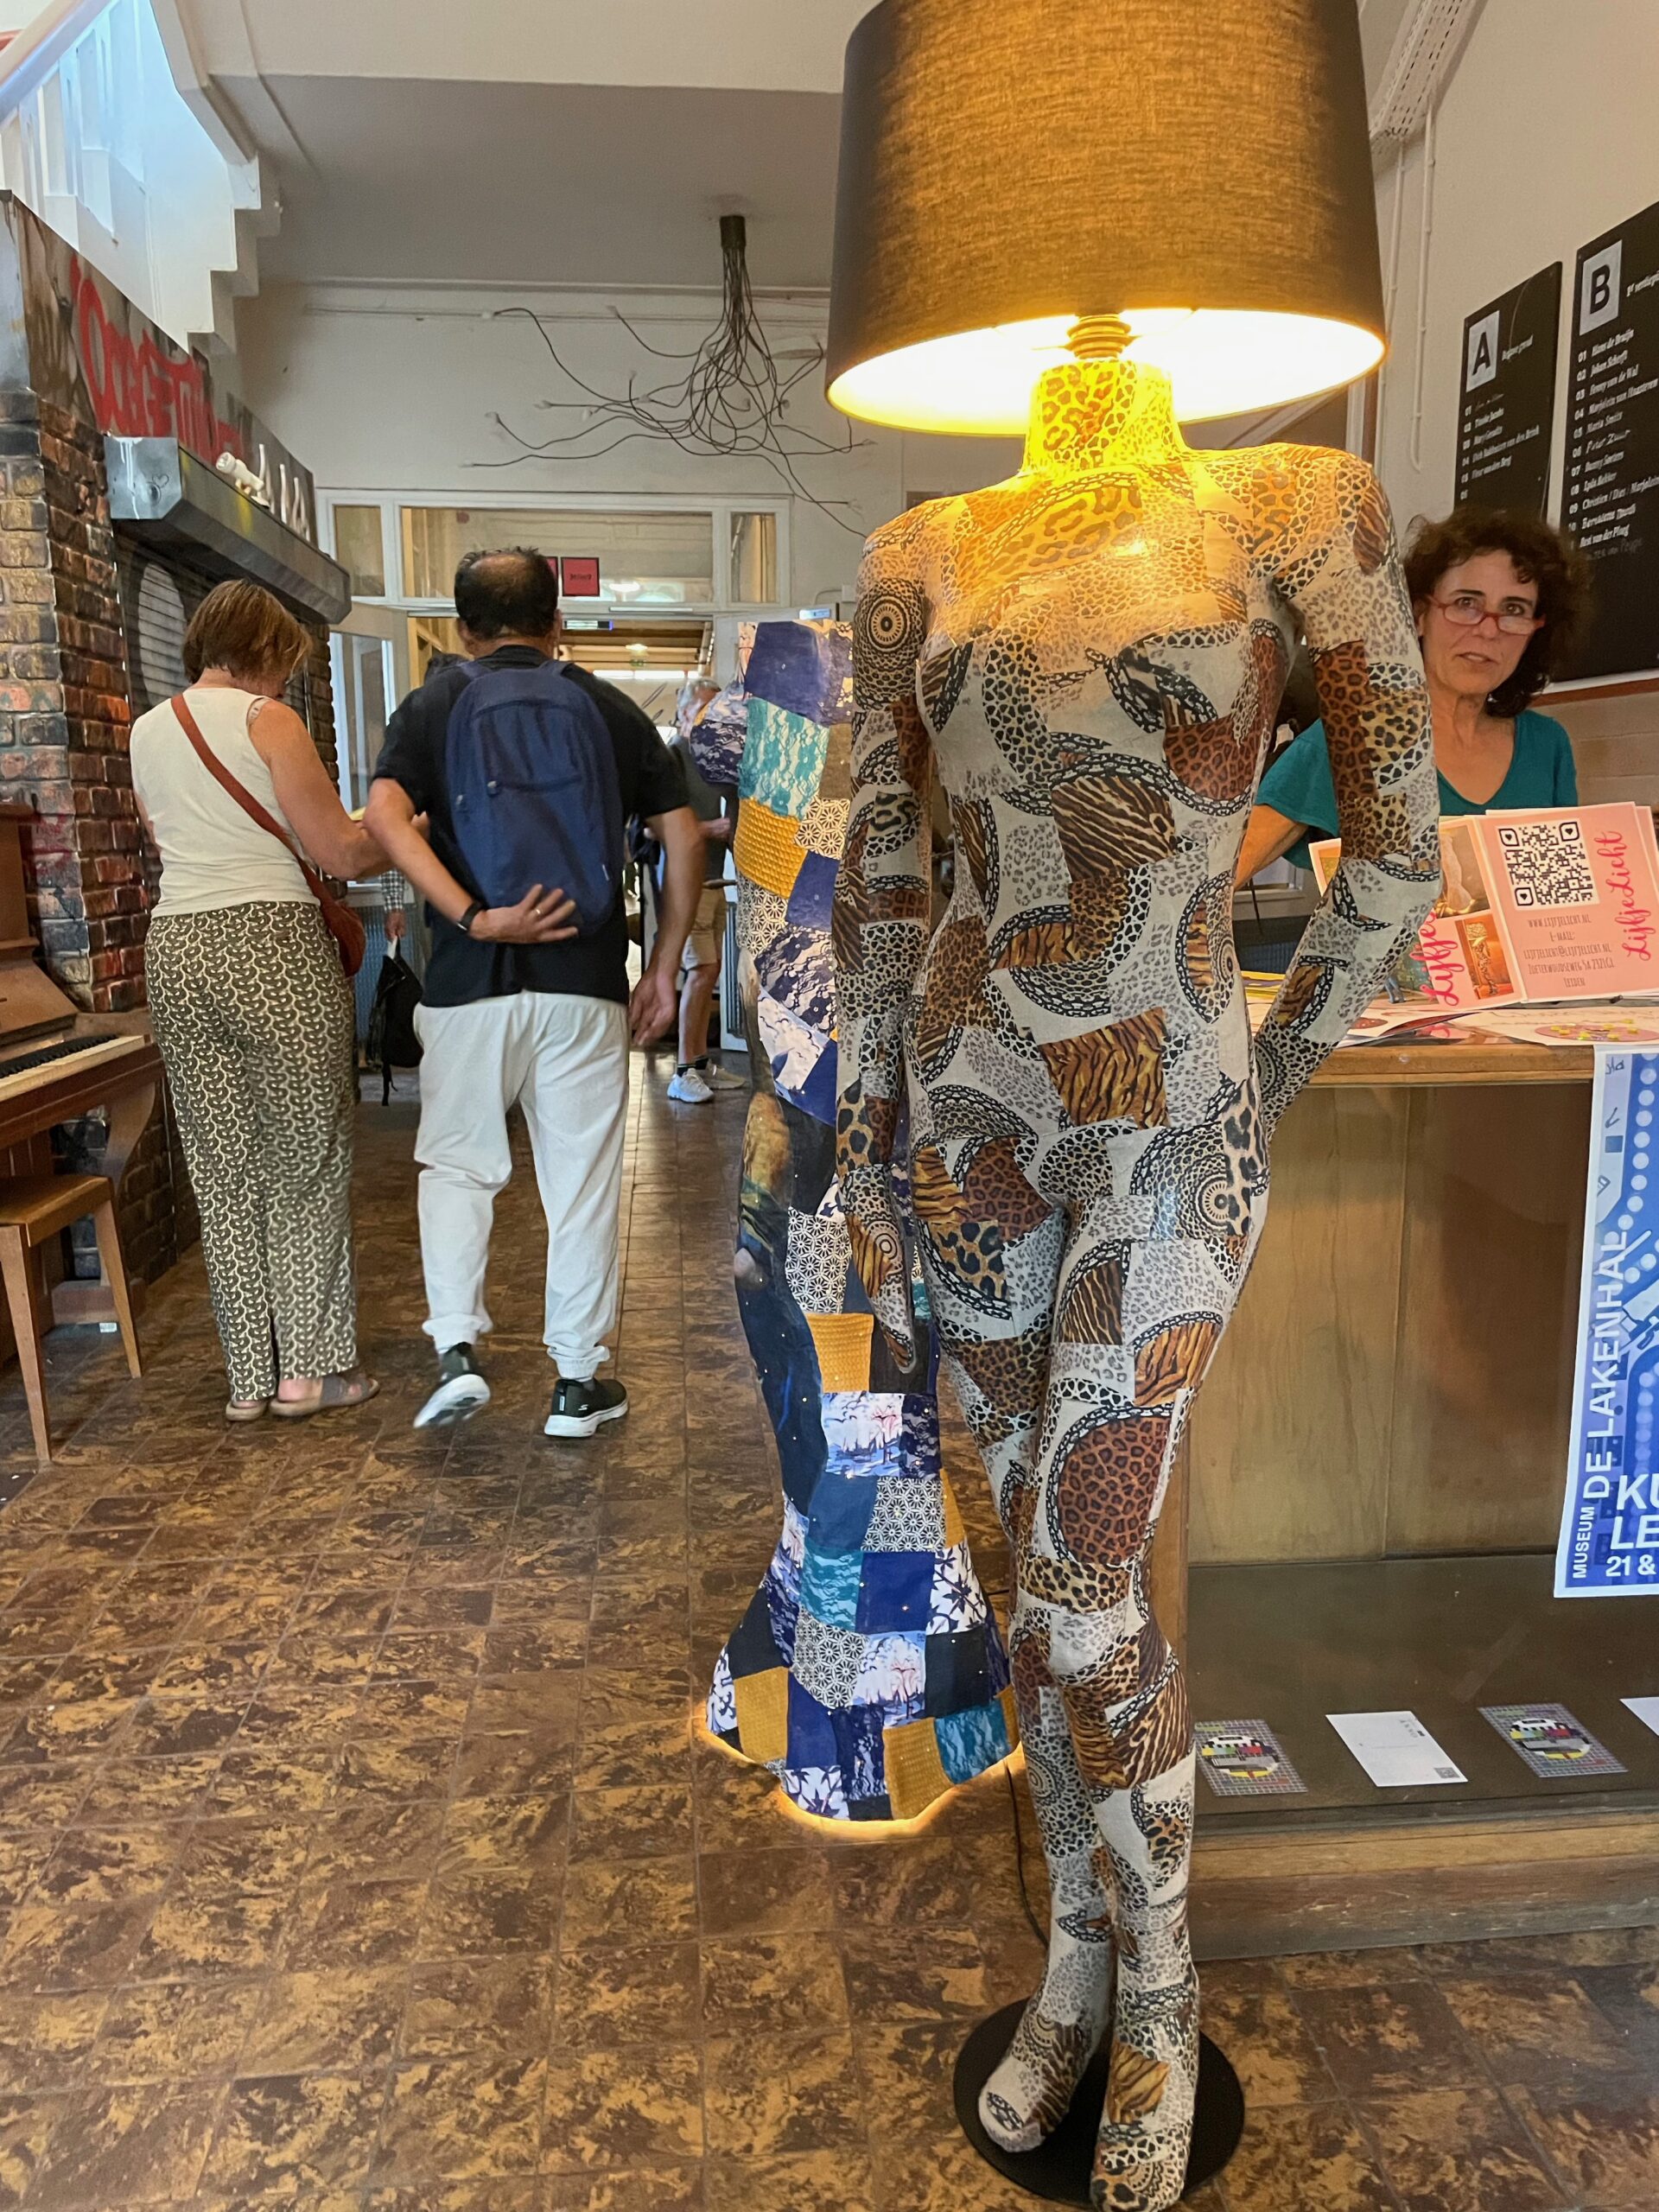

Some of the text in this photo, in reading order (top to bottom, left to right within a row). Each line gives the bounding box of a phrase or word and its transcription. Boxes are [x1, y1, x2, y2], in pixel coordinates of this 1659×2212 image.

[1590, 264, 1610, 314] B
[1471, 331, 1491, 375] A
[1579, 351, 1586, 362] 01
[1577, 369, 1586, 381] 02
[1576, 389, 1585, 401] 03
[1575, 408, 1584, 420] 04
[1573, 427, 1582, 438] 05
[1573, 446, 1581, 458] 06
[1572, 465, 1581, 477] 07
[1569, 503, 1578, 514] 09
[1573, 1230, 1629, 1579] MUSEUM DE LAKENHAL
[1605, 1554, 1656, 1577] 21 &
